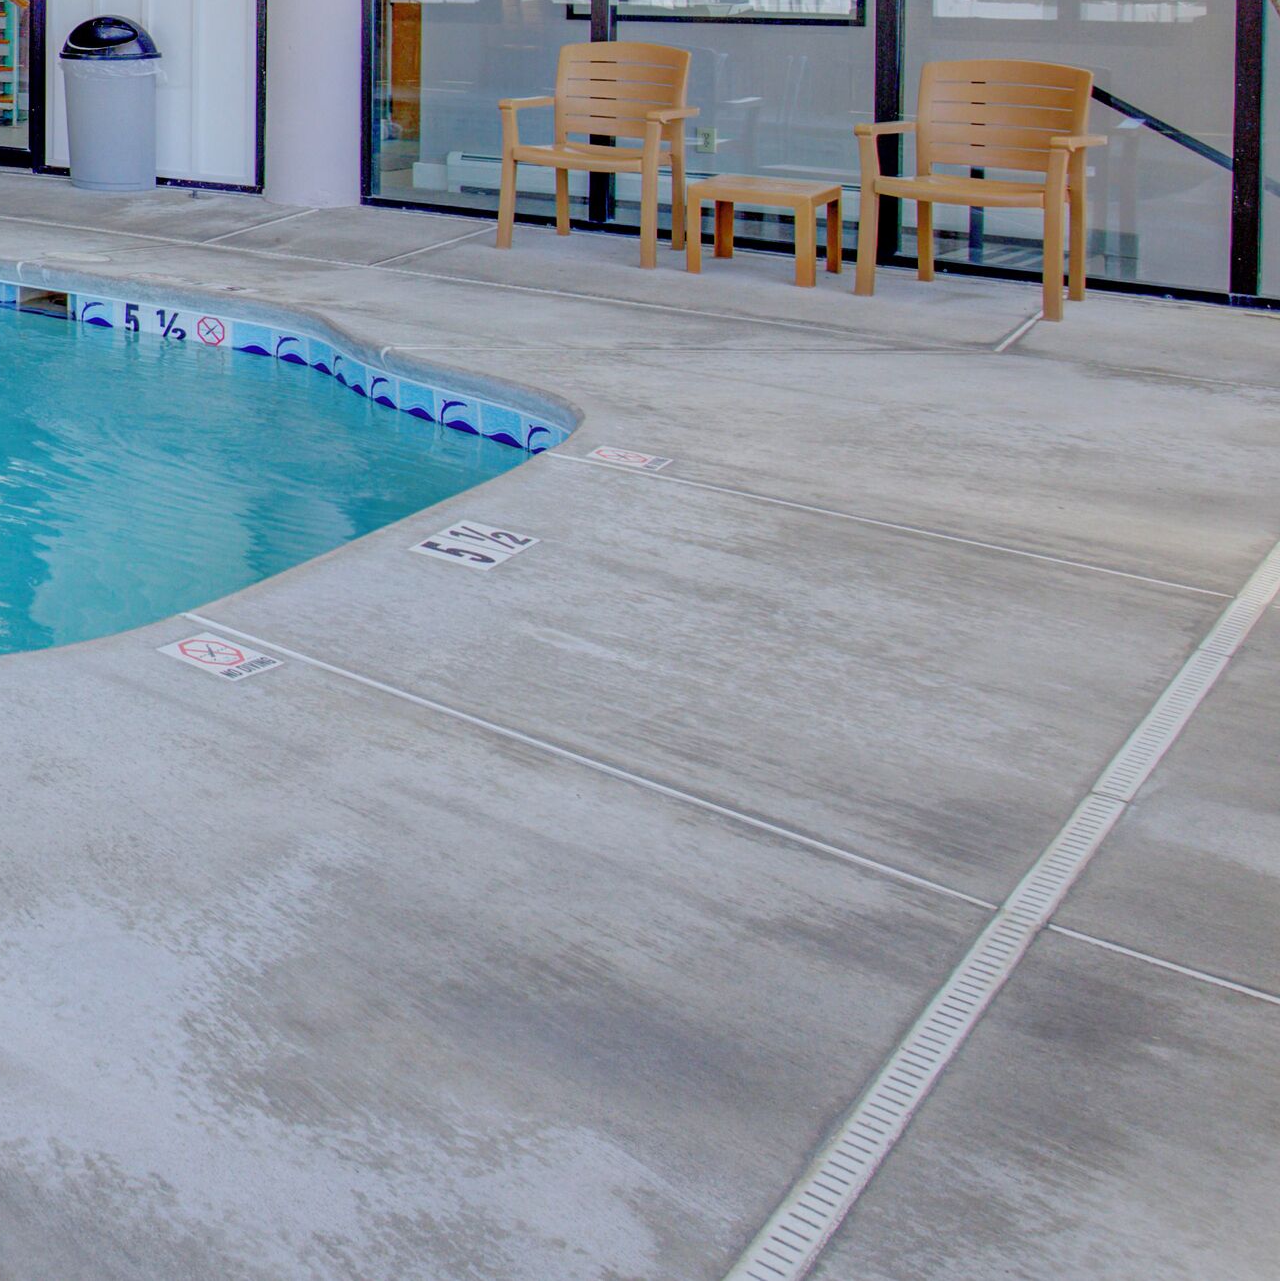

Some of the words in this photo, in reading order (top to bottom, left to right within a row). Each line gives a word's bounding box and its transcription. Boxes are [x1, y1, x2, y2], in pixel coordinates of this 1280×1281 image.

[125, 302, 139, 332] 5
[420, 540, 496, 563] 5
[220, 668, 243, 678] NO
[236, 656, 277, 673] DIVING
